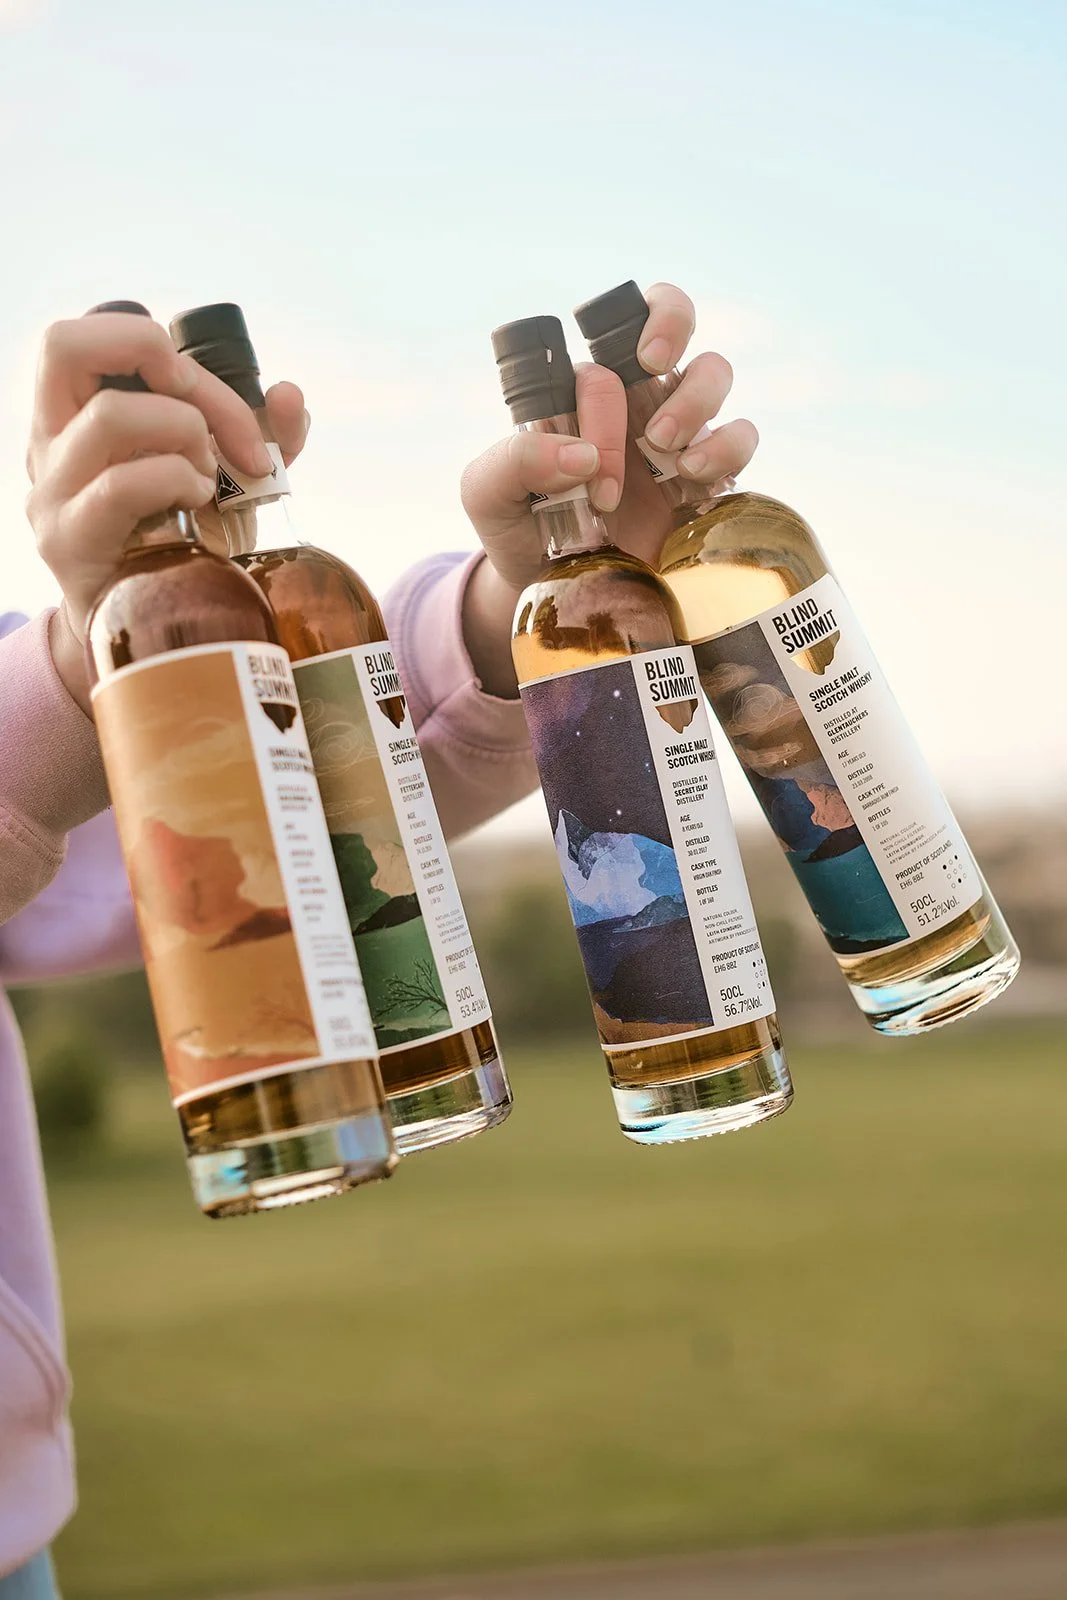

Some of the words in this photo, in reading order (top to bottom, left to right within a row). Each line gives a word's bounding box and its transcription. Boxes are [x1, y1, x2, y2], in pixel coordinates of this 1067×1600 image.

[772, 598, 819, 635] BLIND
[782, 609, 837, 654] SUMMIT
[248, 655, 287, 678] BLIND
[364, 652, 394, 674] BLIND
[645, 656, 684, 681] BLIND
[650, 676, 696, 702] SUMMIT
[809, 679, 840, 702] SINGLE
[840, 666, 859, 684] MALT
[814, 688, 848, 712] SCOTCH
[848, 671, 872, 693] WHISKY
[824, 711, 851, 730] DISTILLED
[851, 706, 858, 716] AT
[827, 710, 868, 737] GLENTAUCHERS
[831, 724, 861, 744] DISTILLERY
[388, 739, 410, 753] SINGLE
[665, 742, 693, 757] SINGLE
[694, 739, 708, 751] MALT
[392, 752, 416, 765] SCOTCH
[668, 753, 698, 769] SCOTCH
[838, 750, 849, 759] AGE
[848, 763, 874, 780] DISTILLED
[672, 776, 698, 788] DISTILLED
[674, 787, 695, 797] SECRET
[676, 793, 704, 806] DISTILLERY
[858, 790, 872, 801] CASK
[872, 783, 885, 794] TYPE
[680, 814, 691, 822] AGE
[868, 807, 891, 823] BOTTLES
[685, 836, 710, 847] DISTILLED
[691, 861, 705, 871] CASK
[705, 859, 717, 867] TYPE
[896, 861, 923, 880] PRODUCT
[923, 856, 930, 865] OF
[930, 840, 952, 860] SCOTLAND
[696, 885, 718, 895] BOTTLES
[900, 879, 913, 890] EH6
[910, 894, 936, 913] 50CL
[712, 949, 738, 963] PRODUCT
[738, 947, 744, 956] OF
[714, 963, 726, 974] EH6
[456, 986, 474, 1002] 50CL
[720, 985, 744, 1001] 50CL
